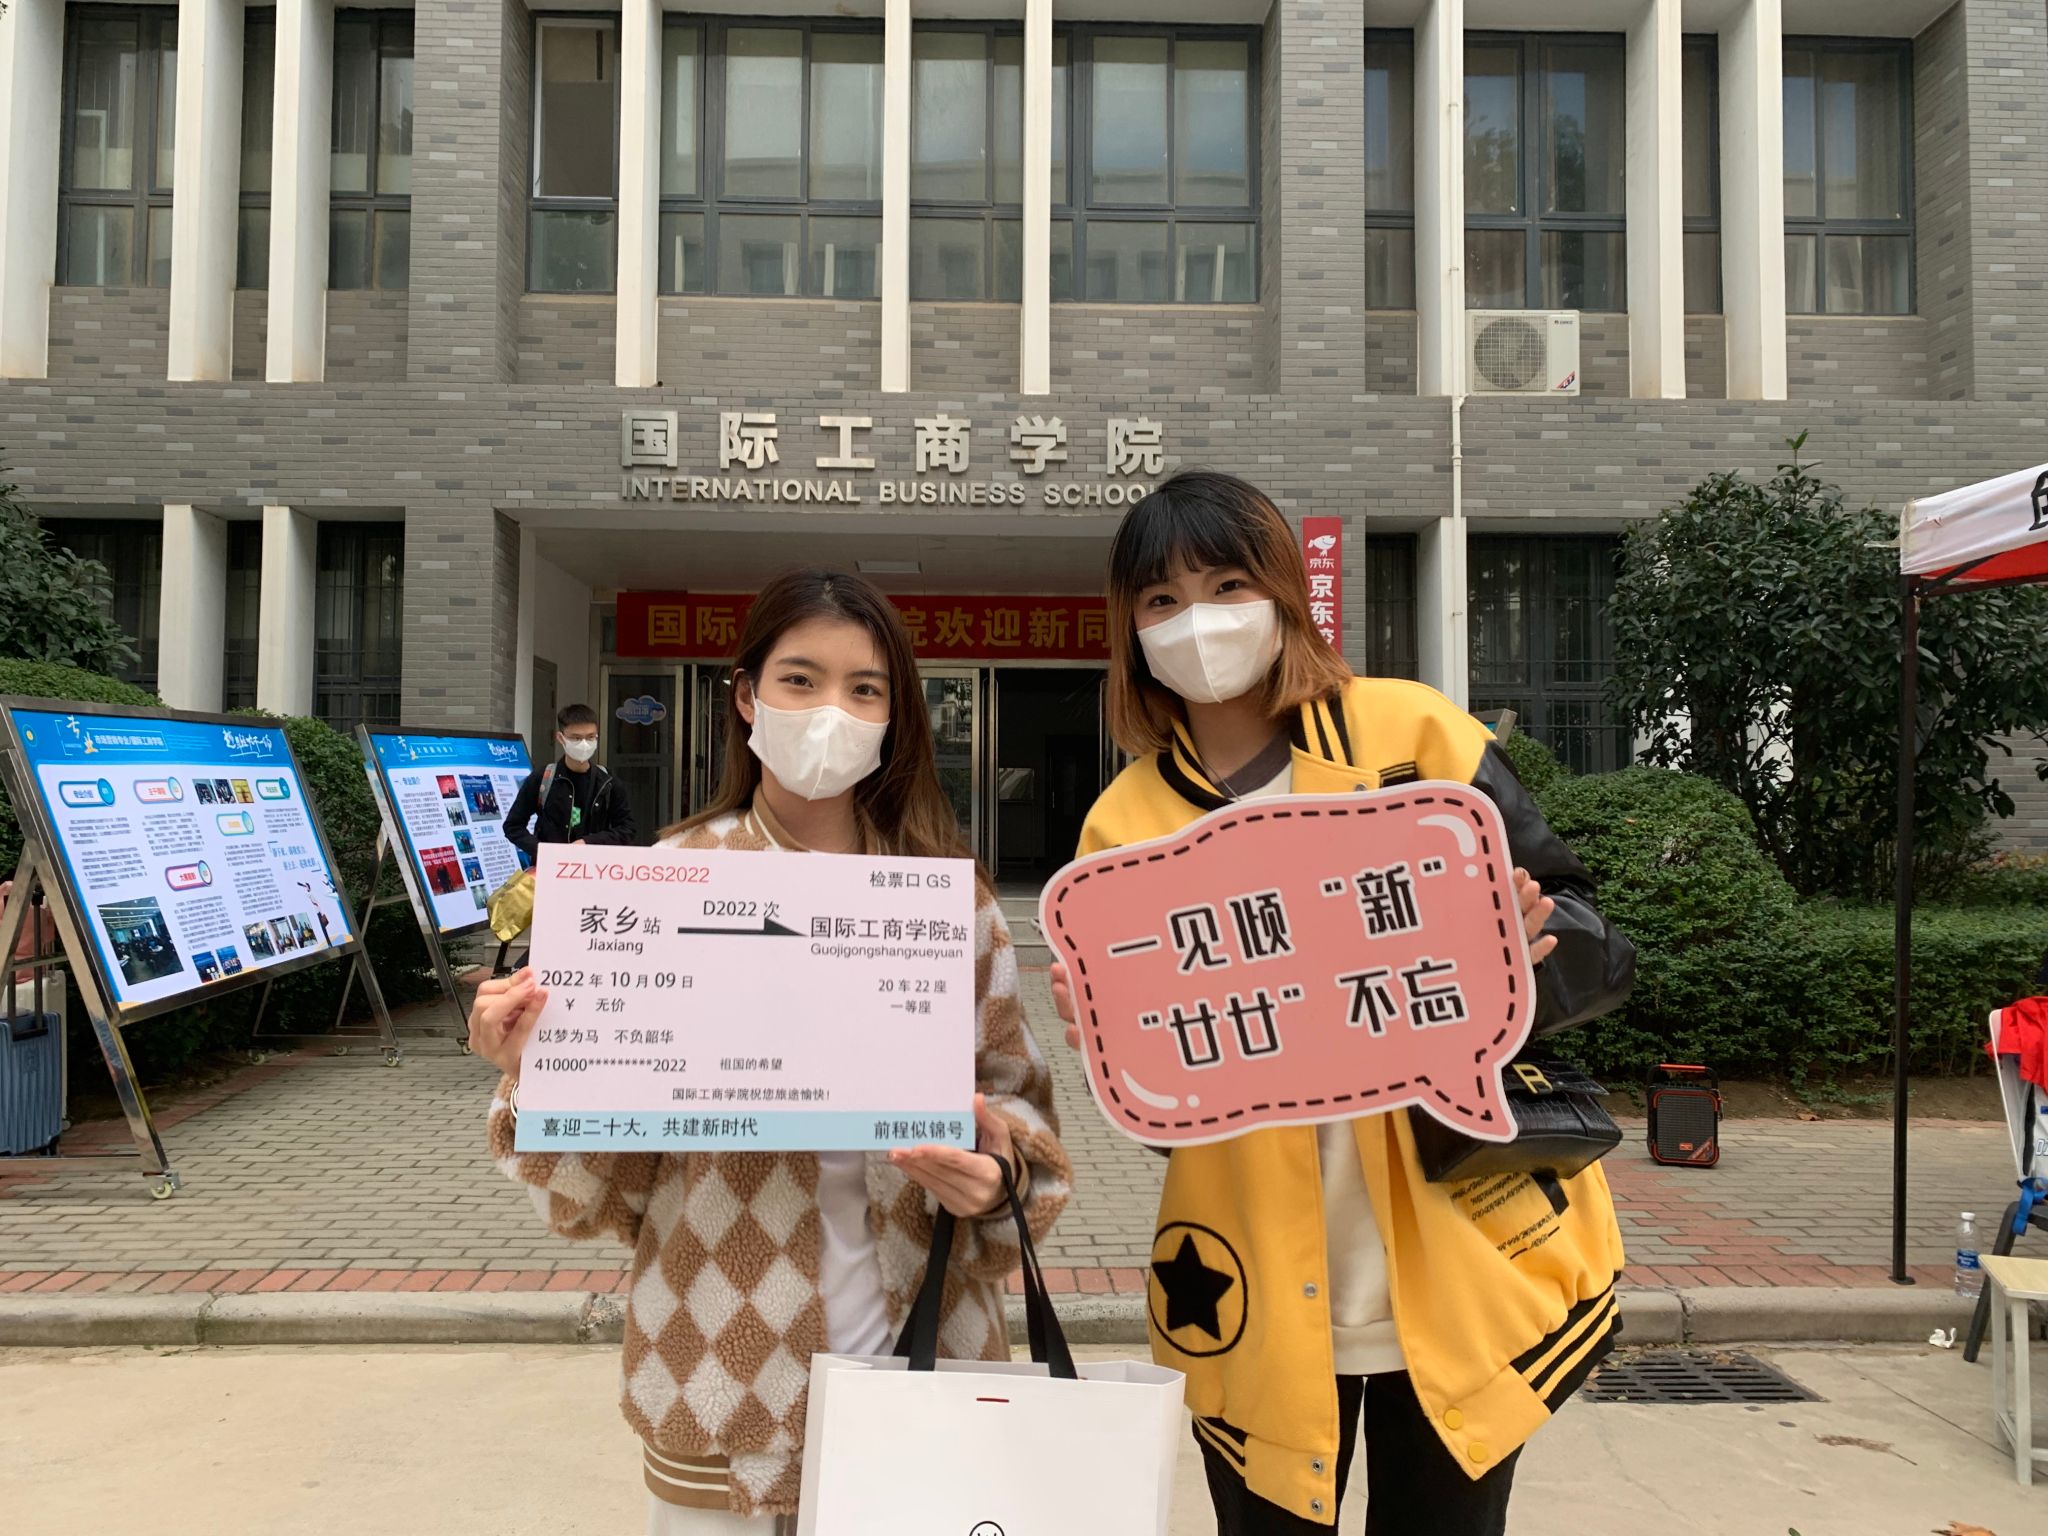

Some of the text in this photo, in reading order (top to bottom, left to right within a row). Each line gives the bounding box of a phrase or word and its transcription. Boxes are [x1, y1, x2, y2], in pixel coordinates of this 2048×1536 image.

[622, 410, 1165, 476] 国际工商学院
[622, 477, 1154, 505] INTERNATIONAL BUSINESS SCHOO
[1309, 558, 1335, 569] 京东
[555, 862, 711, 884] ZZLYGJGS2022
[869, 870, 952, 889] 检票口 GS
[810, 916, 968, 942] 国际工商学院站
[586, 937, 644, 956] Jiaxiang
[595, 998, 626, 1013] 无价
[1338, 959, 1464, 1034] 不忘
[890, 1000, 932, 1015] 一等座
[720, 1058, 784, 1072] 祖国的希望
[874, 1121, 964, 1141] 前程似锦号
